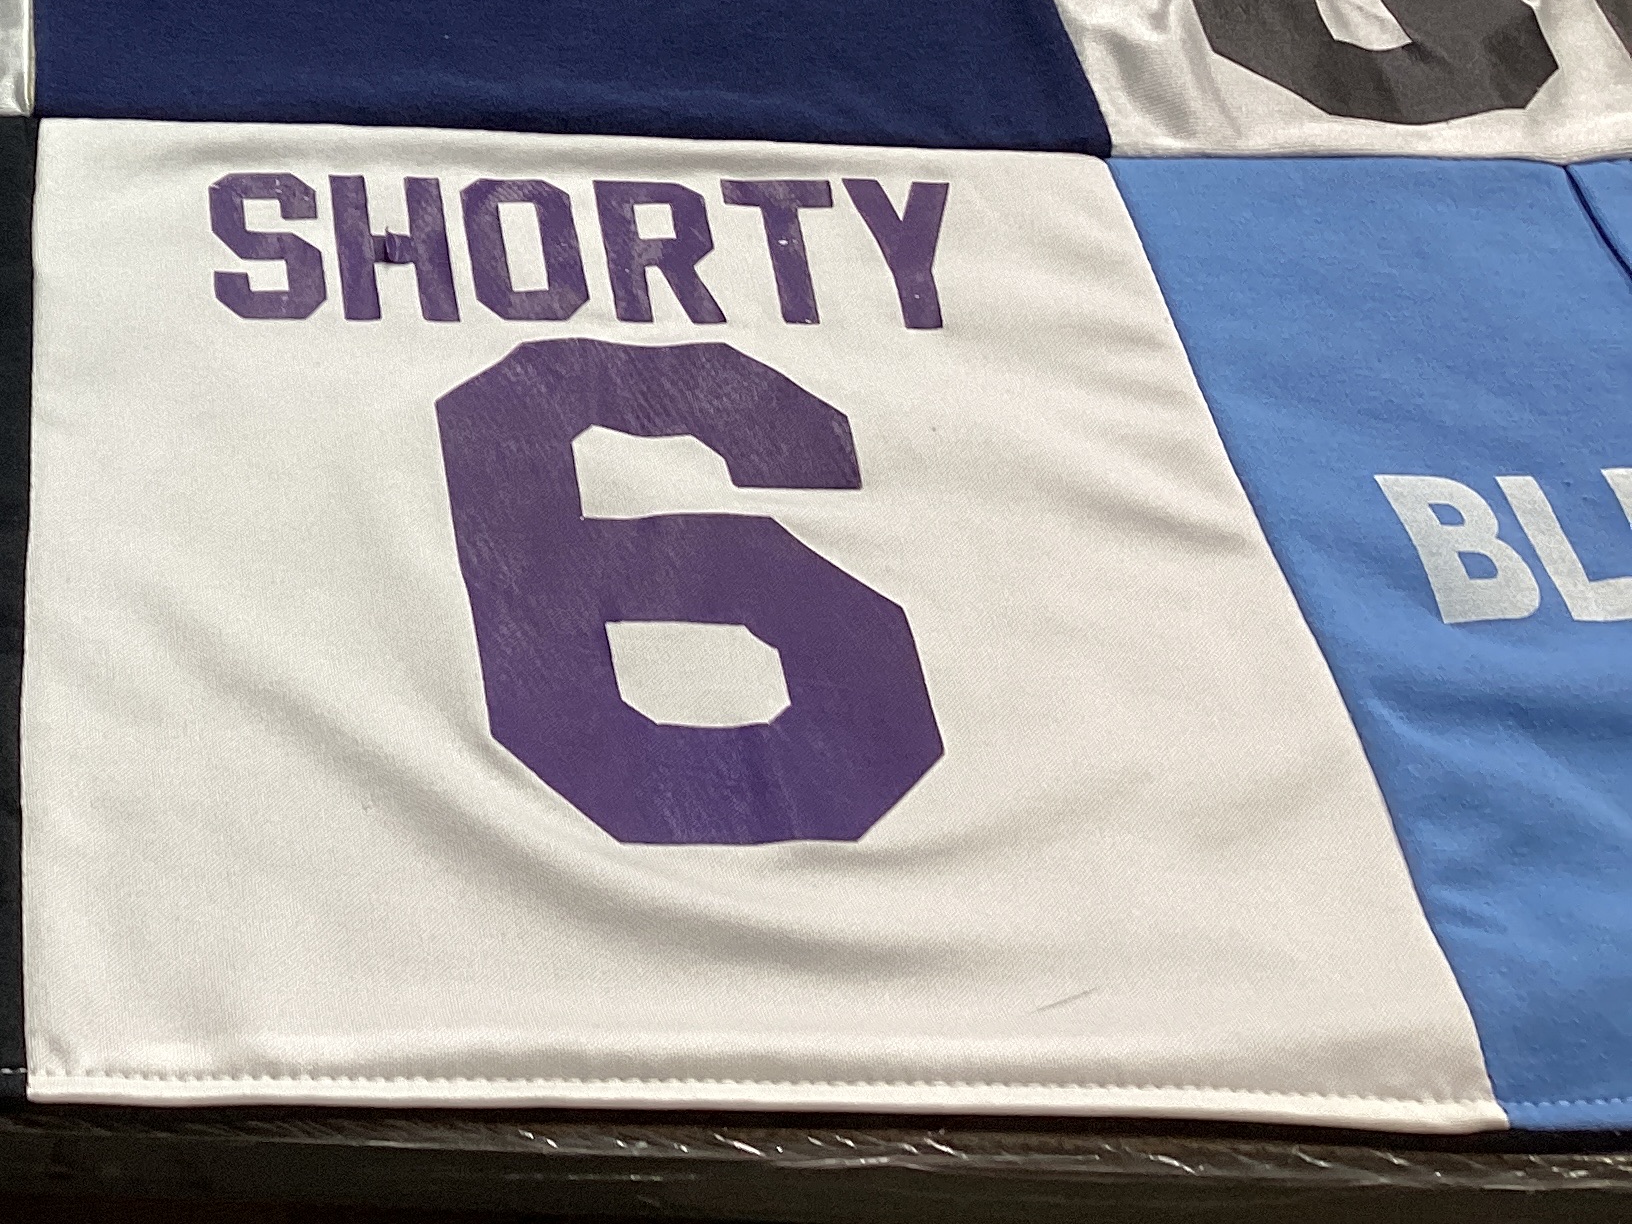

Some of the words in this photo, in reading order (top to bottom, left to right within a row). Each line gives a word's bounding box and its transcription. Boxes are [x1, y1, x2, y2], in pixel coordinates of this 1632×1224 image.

[208, 173, 950, 329] SHORTY
[435, 337, 945, 846] 6
[1374, 468, 1632, 624] BL
